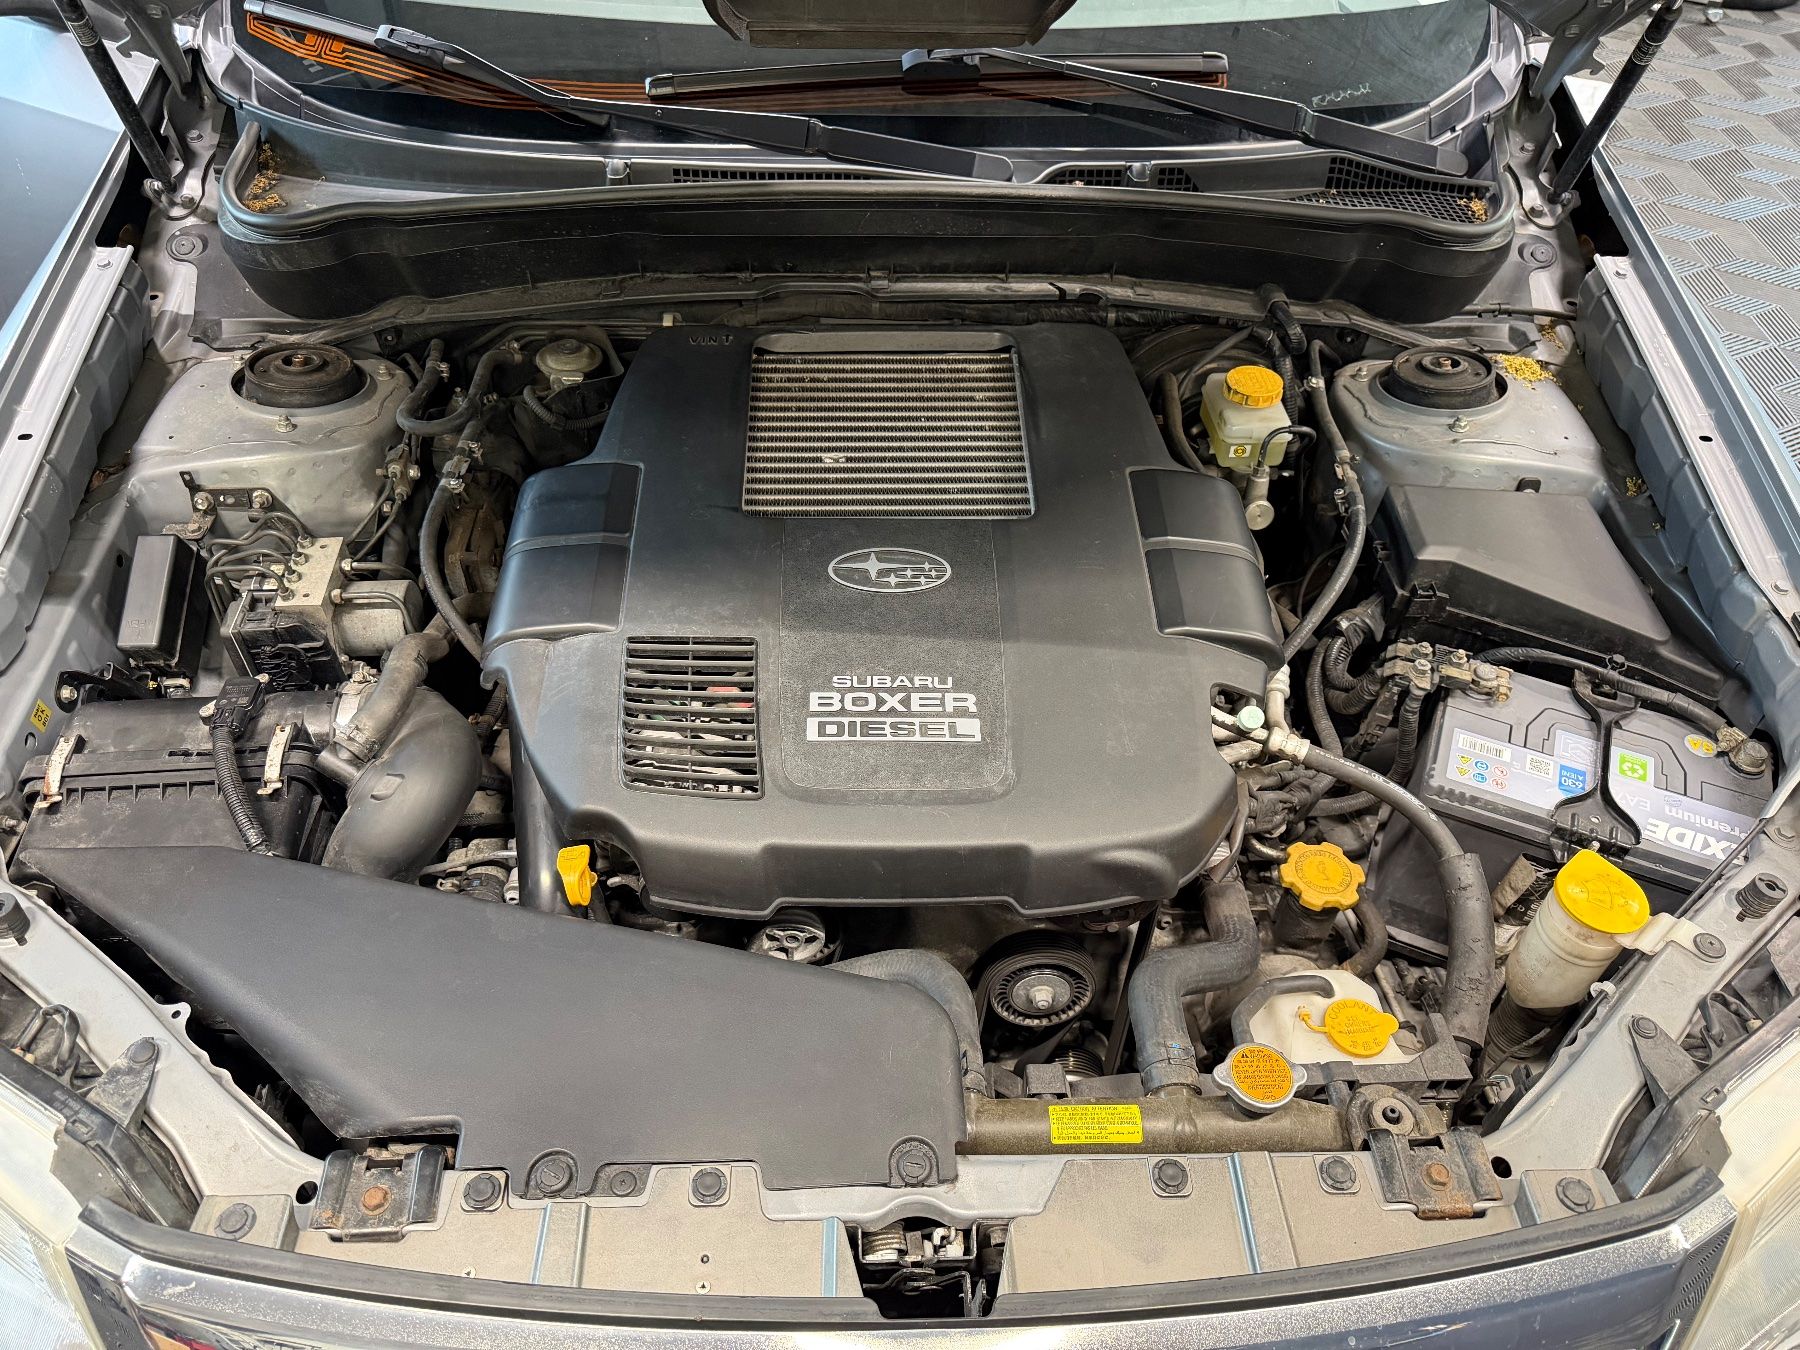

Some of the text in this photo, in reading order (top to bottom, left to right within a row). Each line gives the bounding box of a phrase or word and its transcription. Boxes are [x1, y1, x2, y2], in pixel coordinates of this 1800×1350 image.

[832, 675, 953, 689] SUBARU
[808, 692, 978, 713] BOXER
[815, 719, 976, 739] DIESEL
[1561, 776, 1582, 787] 630
